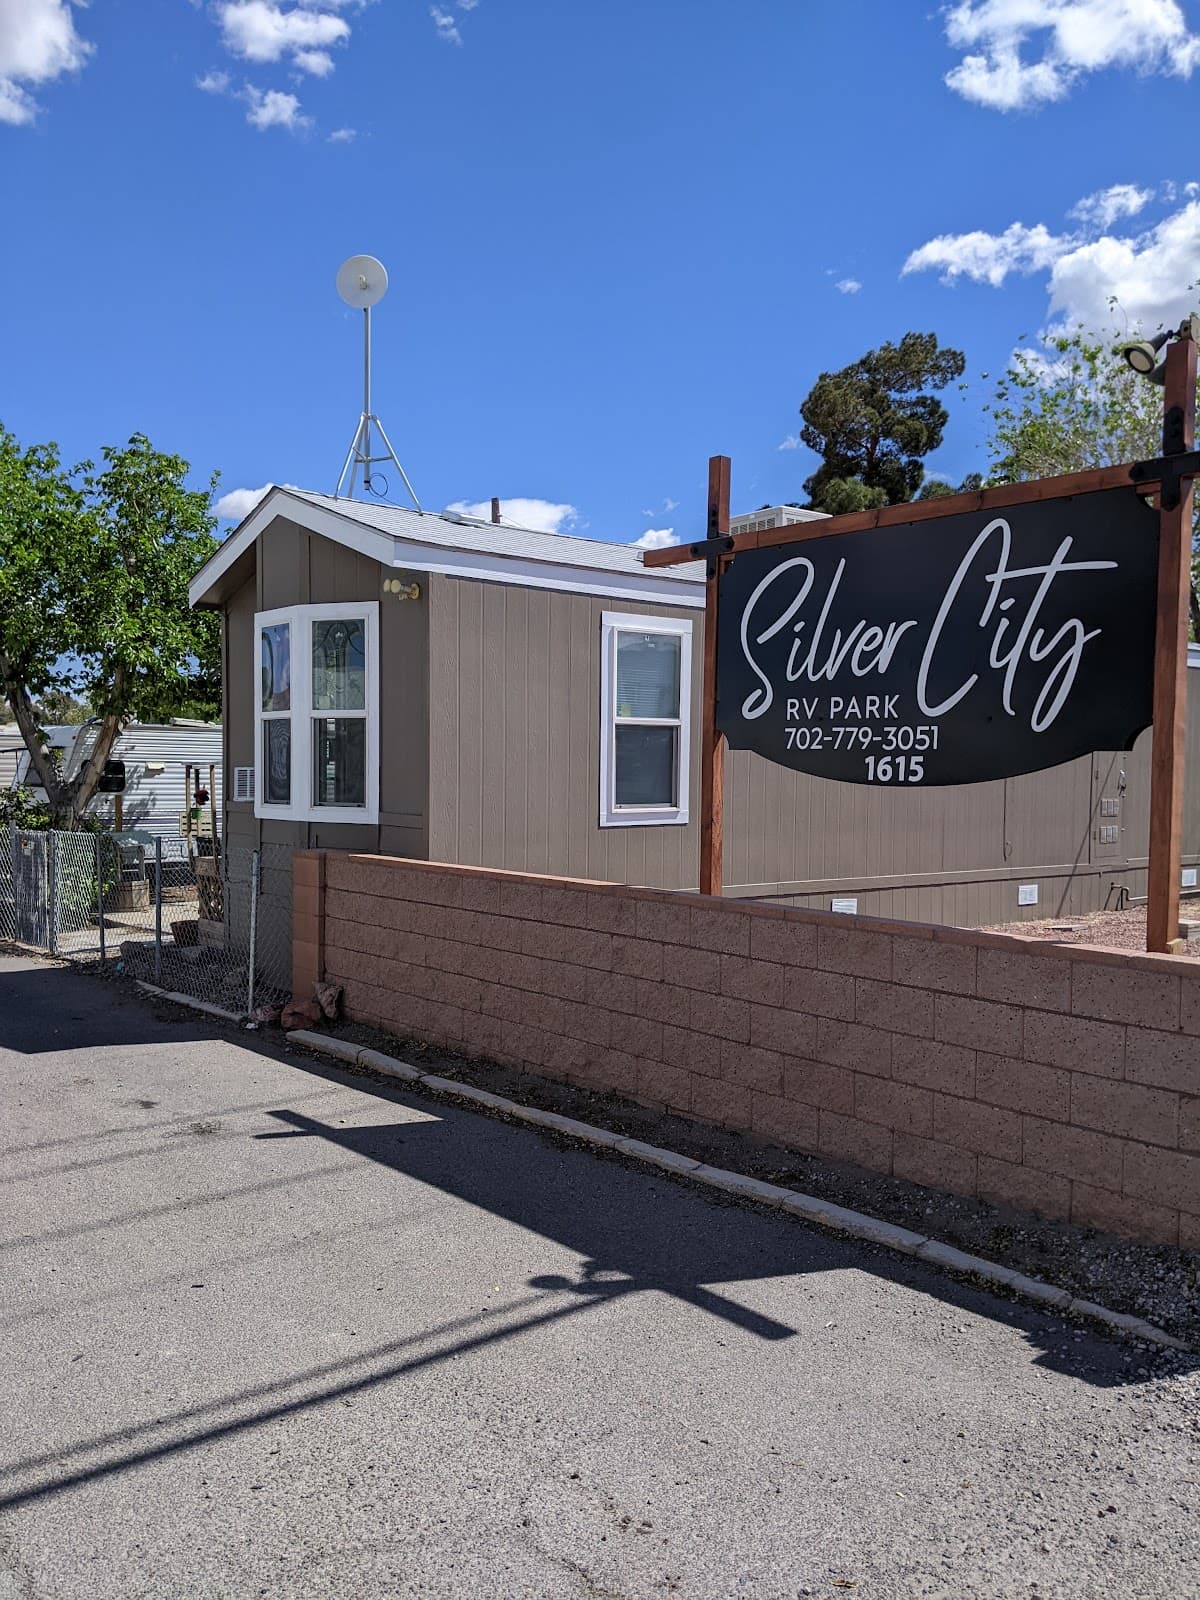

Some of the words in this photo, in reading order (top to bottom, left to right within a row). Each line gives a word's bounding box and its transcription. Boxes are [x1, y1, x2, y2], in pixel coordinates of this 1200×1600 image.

[740, 556, 918, 720] Silver
[916, 518, 1119, 733] City
[786, 698, 819, 720] RV
[829, 694, 900, 720] PARK
[784, 725, 939, 750] 702-779-3051
[864, 755, 924, 782] 1615
